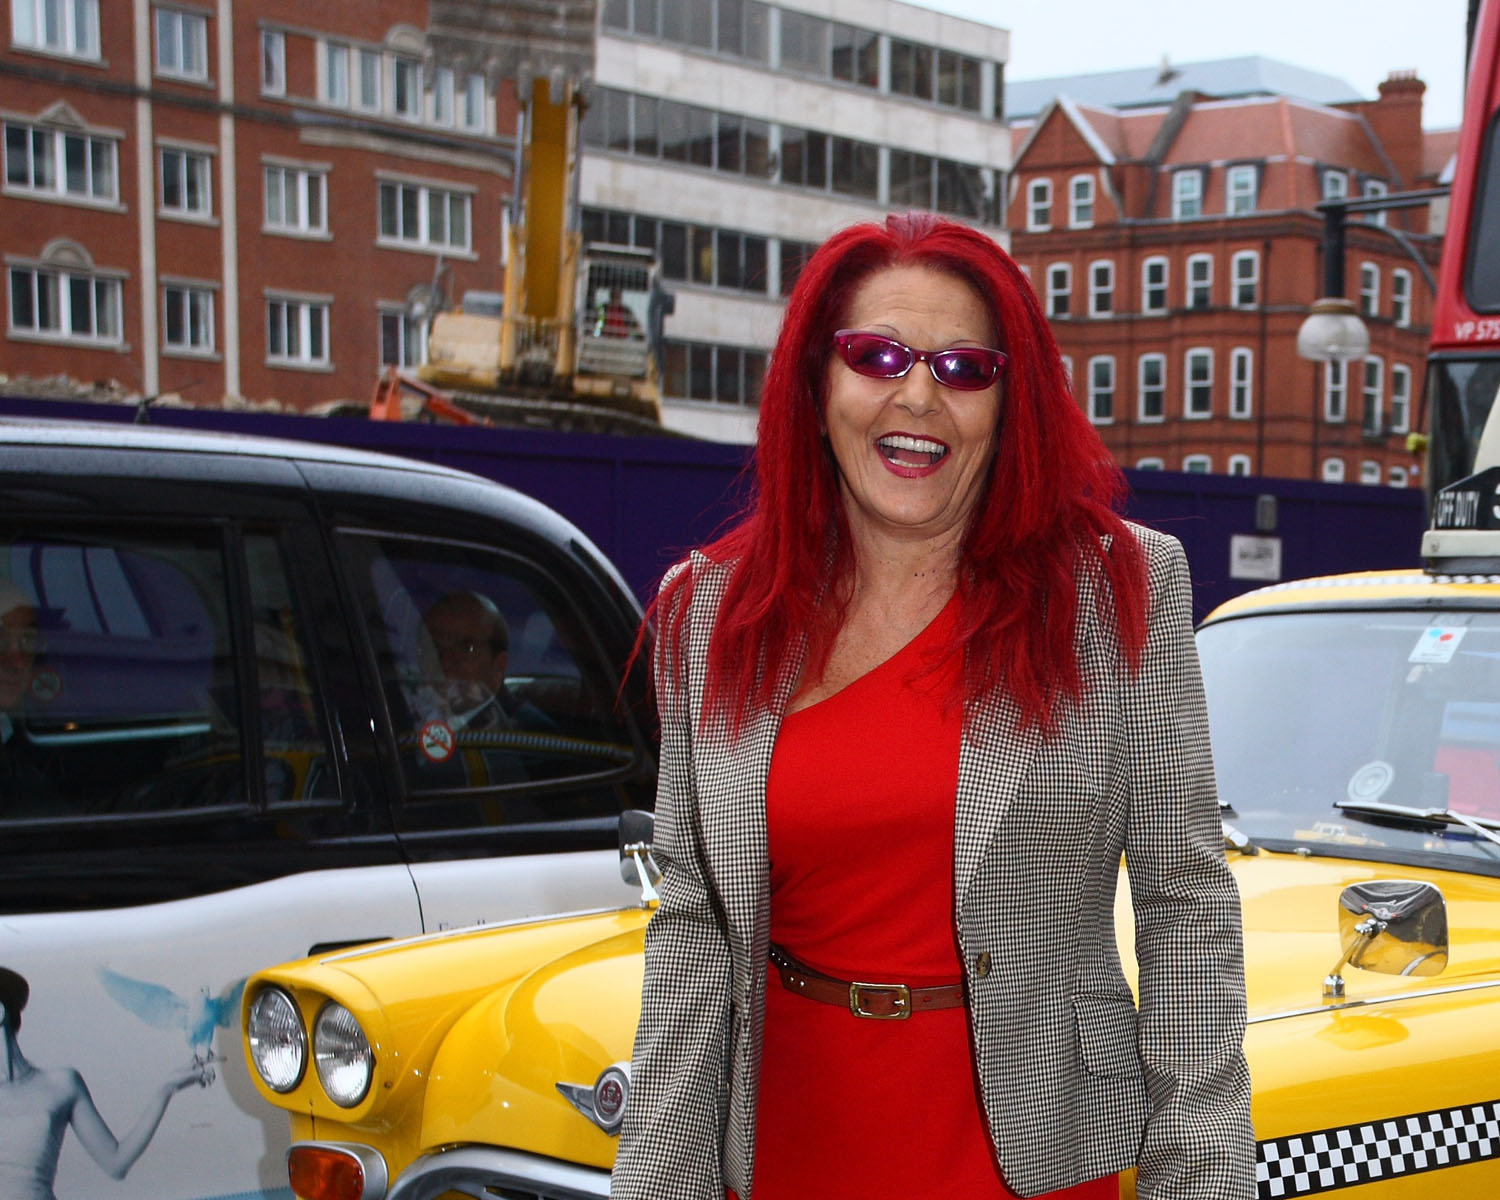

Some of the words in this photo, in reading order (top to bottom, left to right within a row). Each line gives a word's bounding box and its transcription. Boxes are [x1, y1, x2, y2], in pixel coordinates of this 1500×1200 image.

[1454, 322, 1475, 340] VP
[1436, 493, 1456, 527] OFF
[1454, 491, 1480, 527] DUTY
